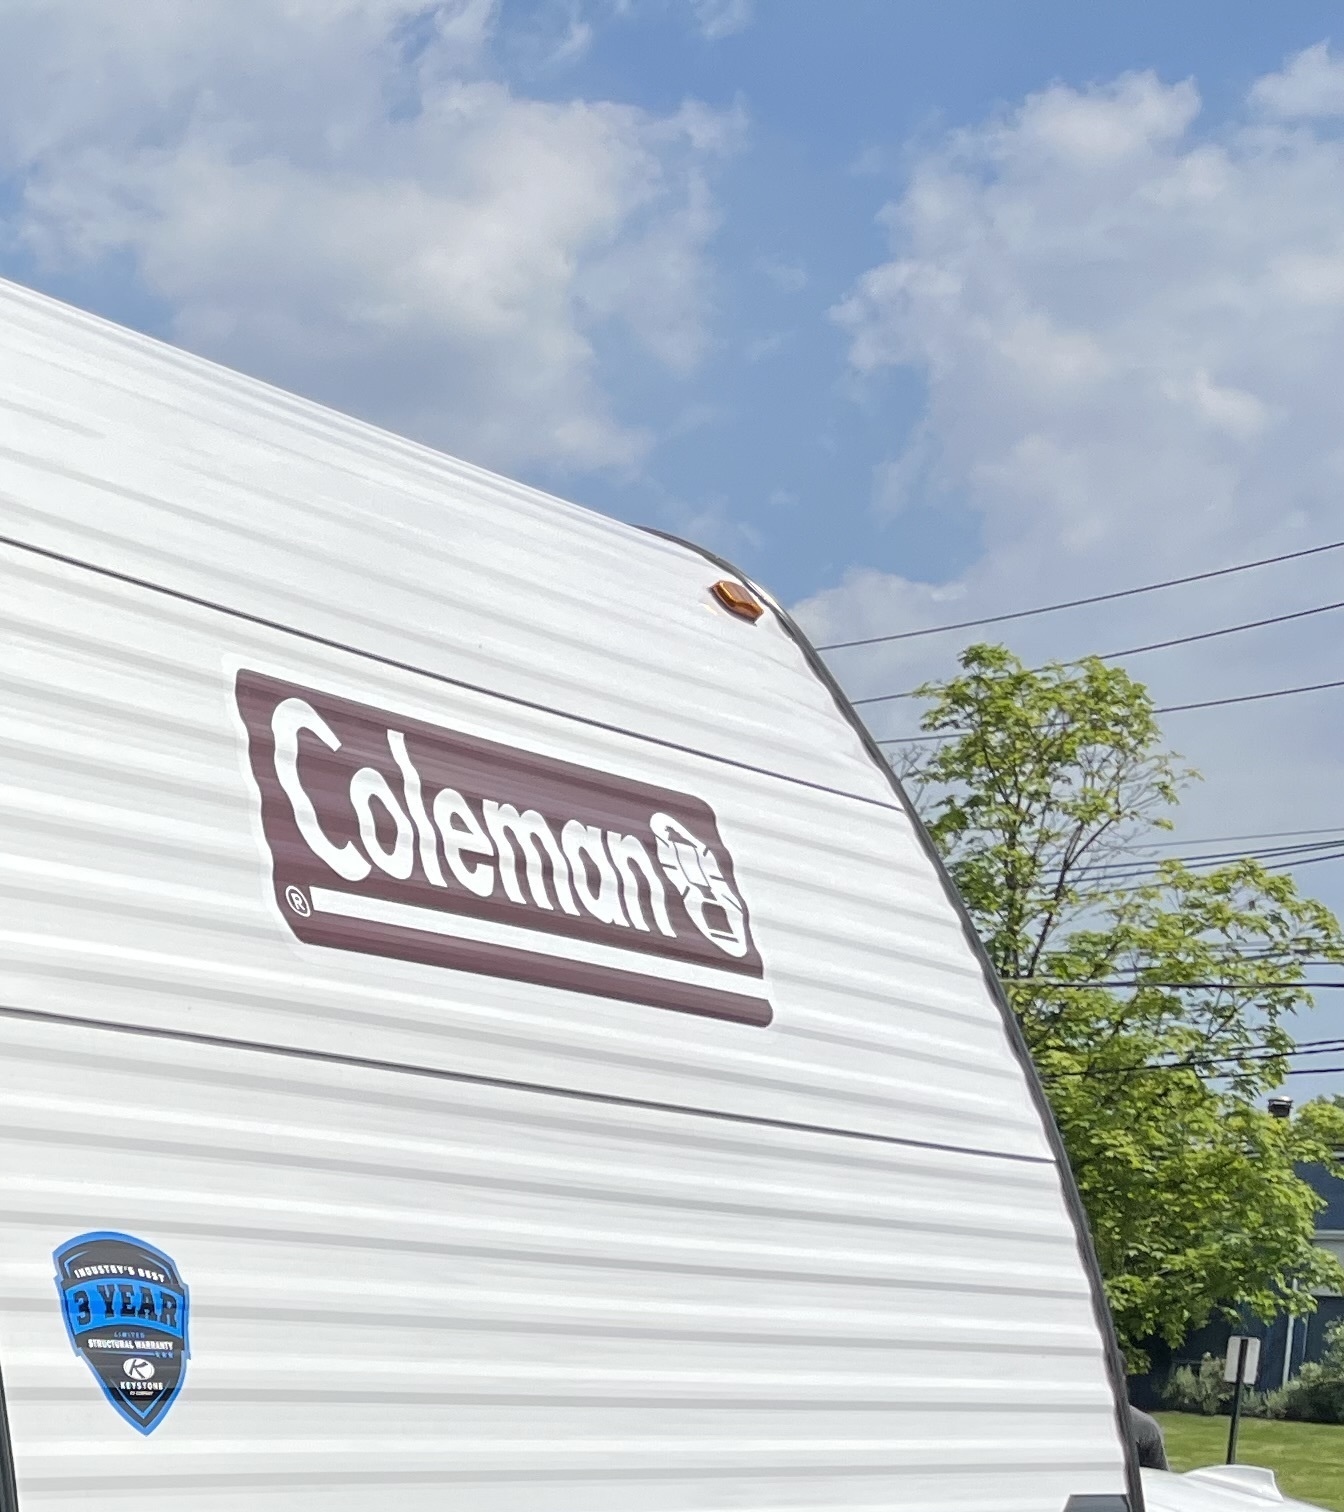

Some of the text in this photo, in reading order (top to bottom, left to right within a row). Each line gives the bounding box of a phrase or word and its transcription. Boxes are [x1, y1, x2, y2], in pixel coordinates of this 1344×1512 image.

[271, 697, 678, 940] Coleman
[74, 1265, 165, 1283] INDUSTRY'S BEST
[73, 1284, 178, 1328] 3 YEAR
[87, 1338, 174, 1351] STRUCTURAL WARRANTY
[120, 1381, 164, 1391] KEYSTONE
